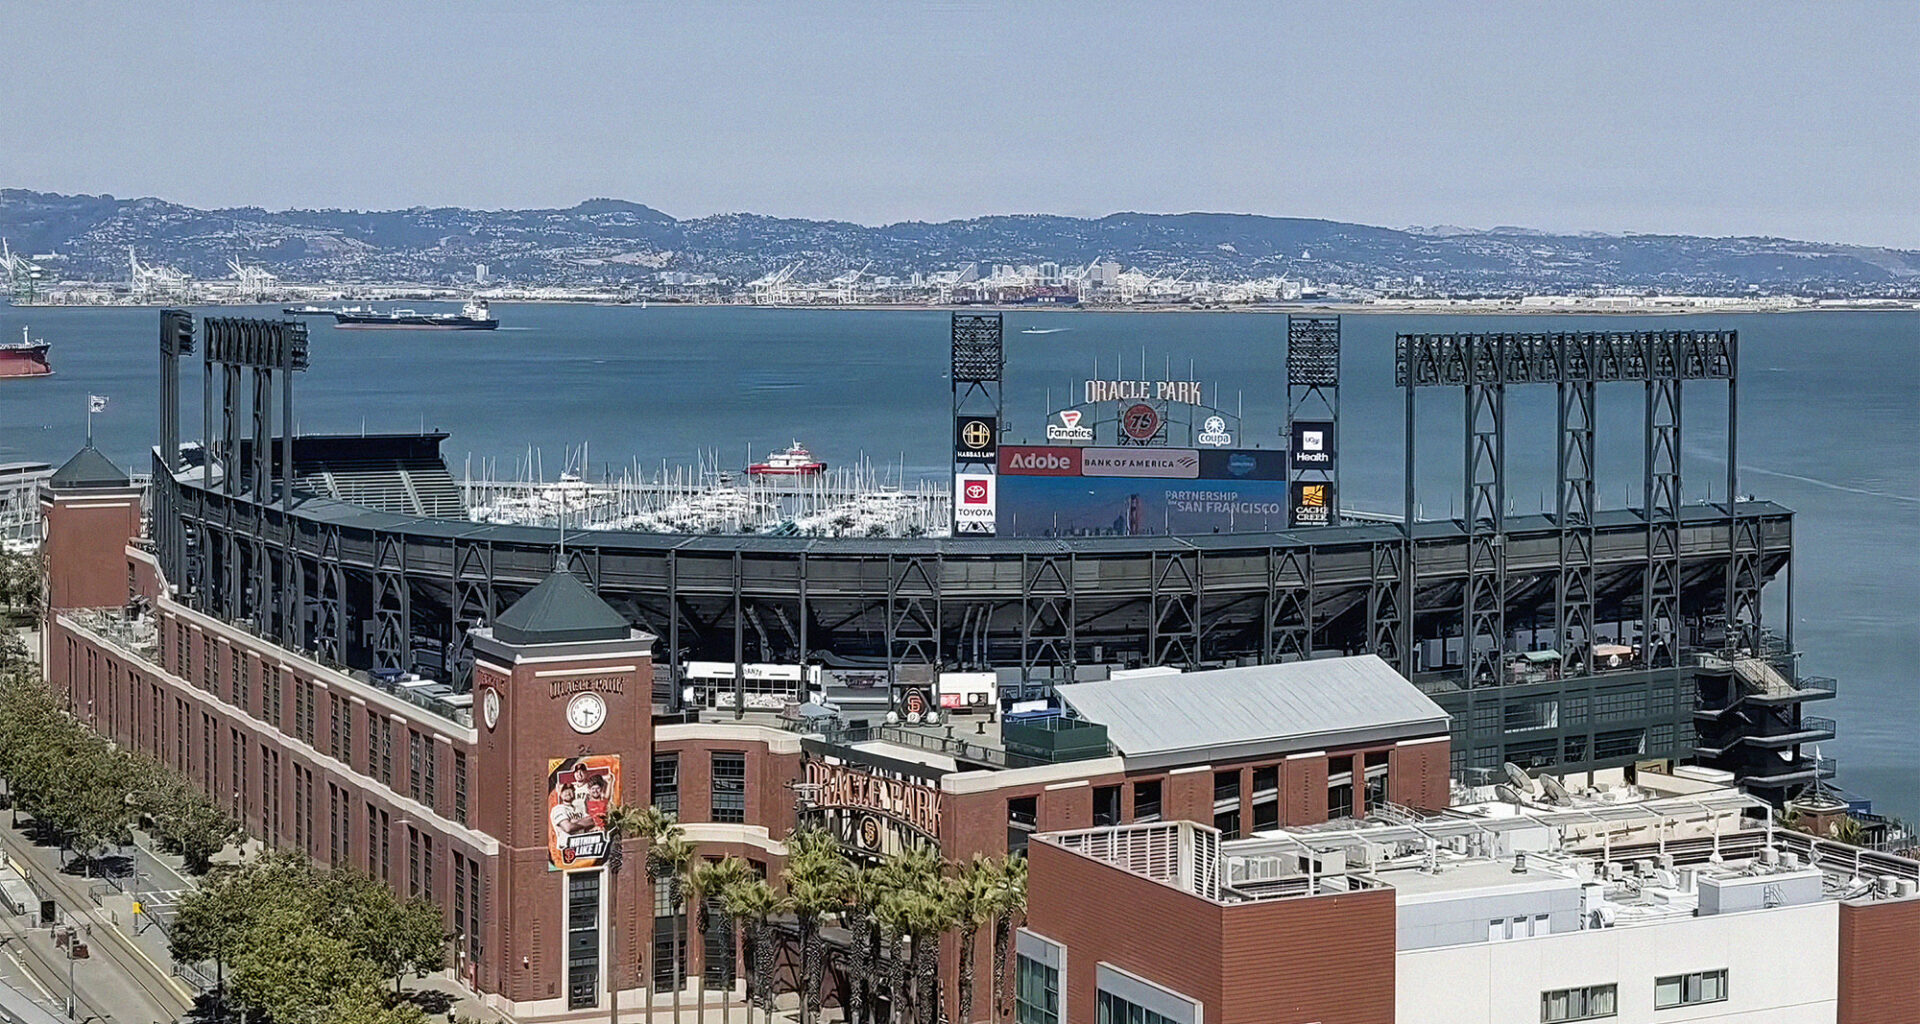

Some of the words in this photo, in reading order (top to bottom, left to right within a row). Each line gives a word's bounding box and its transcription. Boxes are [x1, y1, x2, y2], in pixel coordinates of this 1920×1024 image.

[1085, 380, 1150, 404] ORACLE
[1156, 381, 1202, 406] PARK
[1131, 414, 1151, 429] 76
[1048, 427, 1092, 439] Fanatics
[1200, 433, 1229, 446] coupa
[1009, 453, 1071, 470] Adobe
[1296, 452, 1329, 462] Health
[1084, 458, 1112, 467] BANK
[1113, 459, 1127, 468] OF
[1128, 459, 1175, 469] AMERICA
[1165, 490, 1239, 501] PARTNERSHIP
[958, 508, 993, 517] TOYOTA
[1177, 502, 1203, 512] SAN
[1206, 502, 1280, 514] FRANCISCO
[1295, 506, 1329, 514] CACHE
[806, 760, 883, 811] ORACLE
[889, 779, 943, 838] PARK
[575, 844, 594, 856] LIKE
[593, 842, 604, 855] IT
